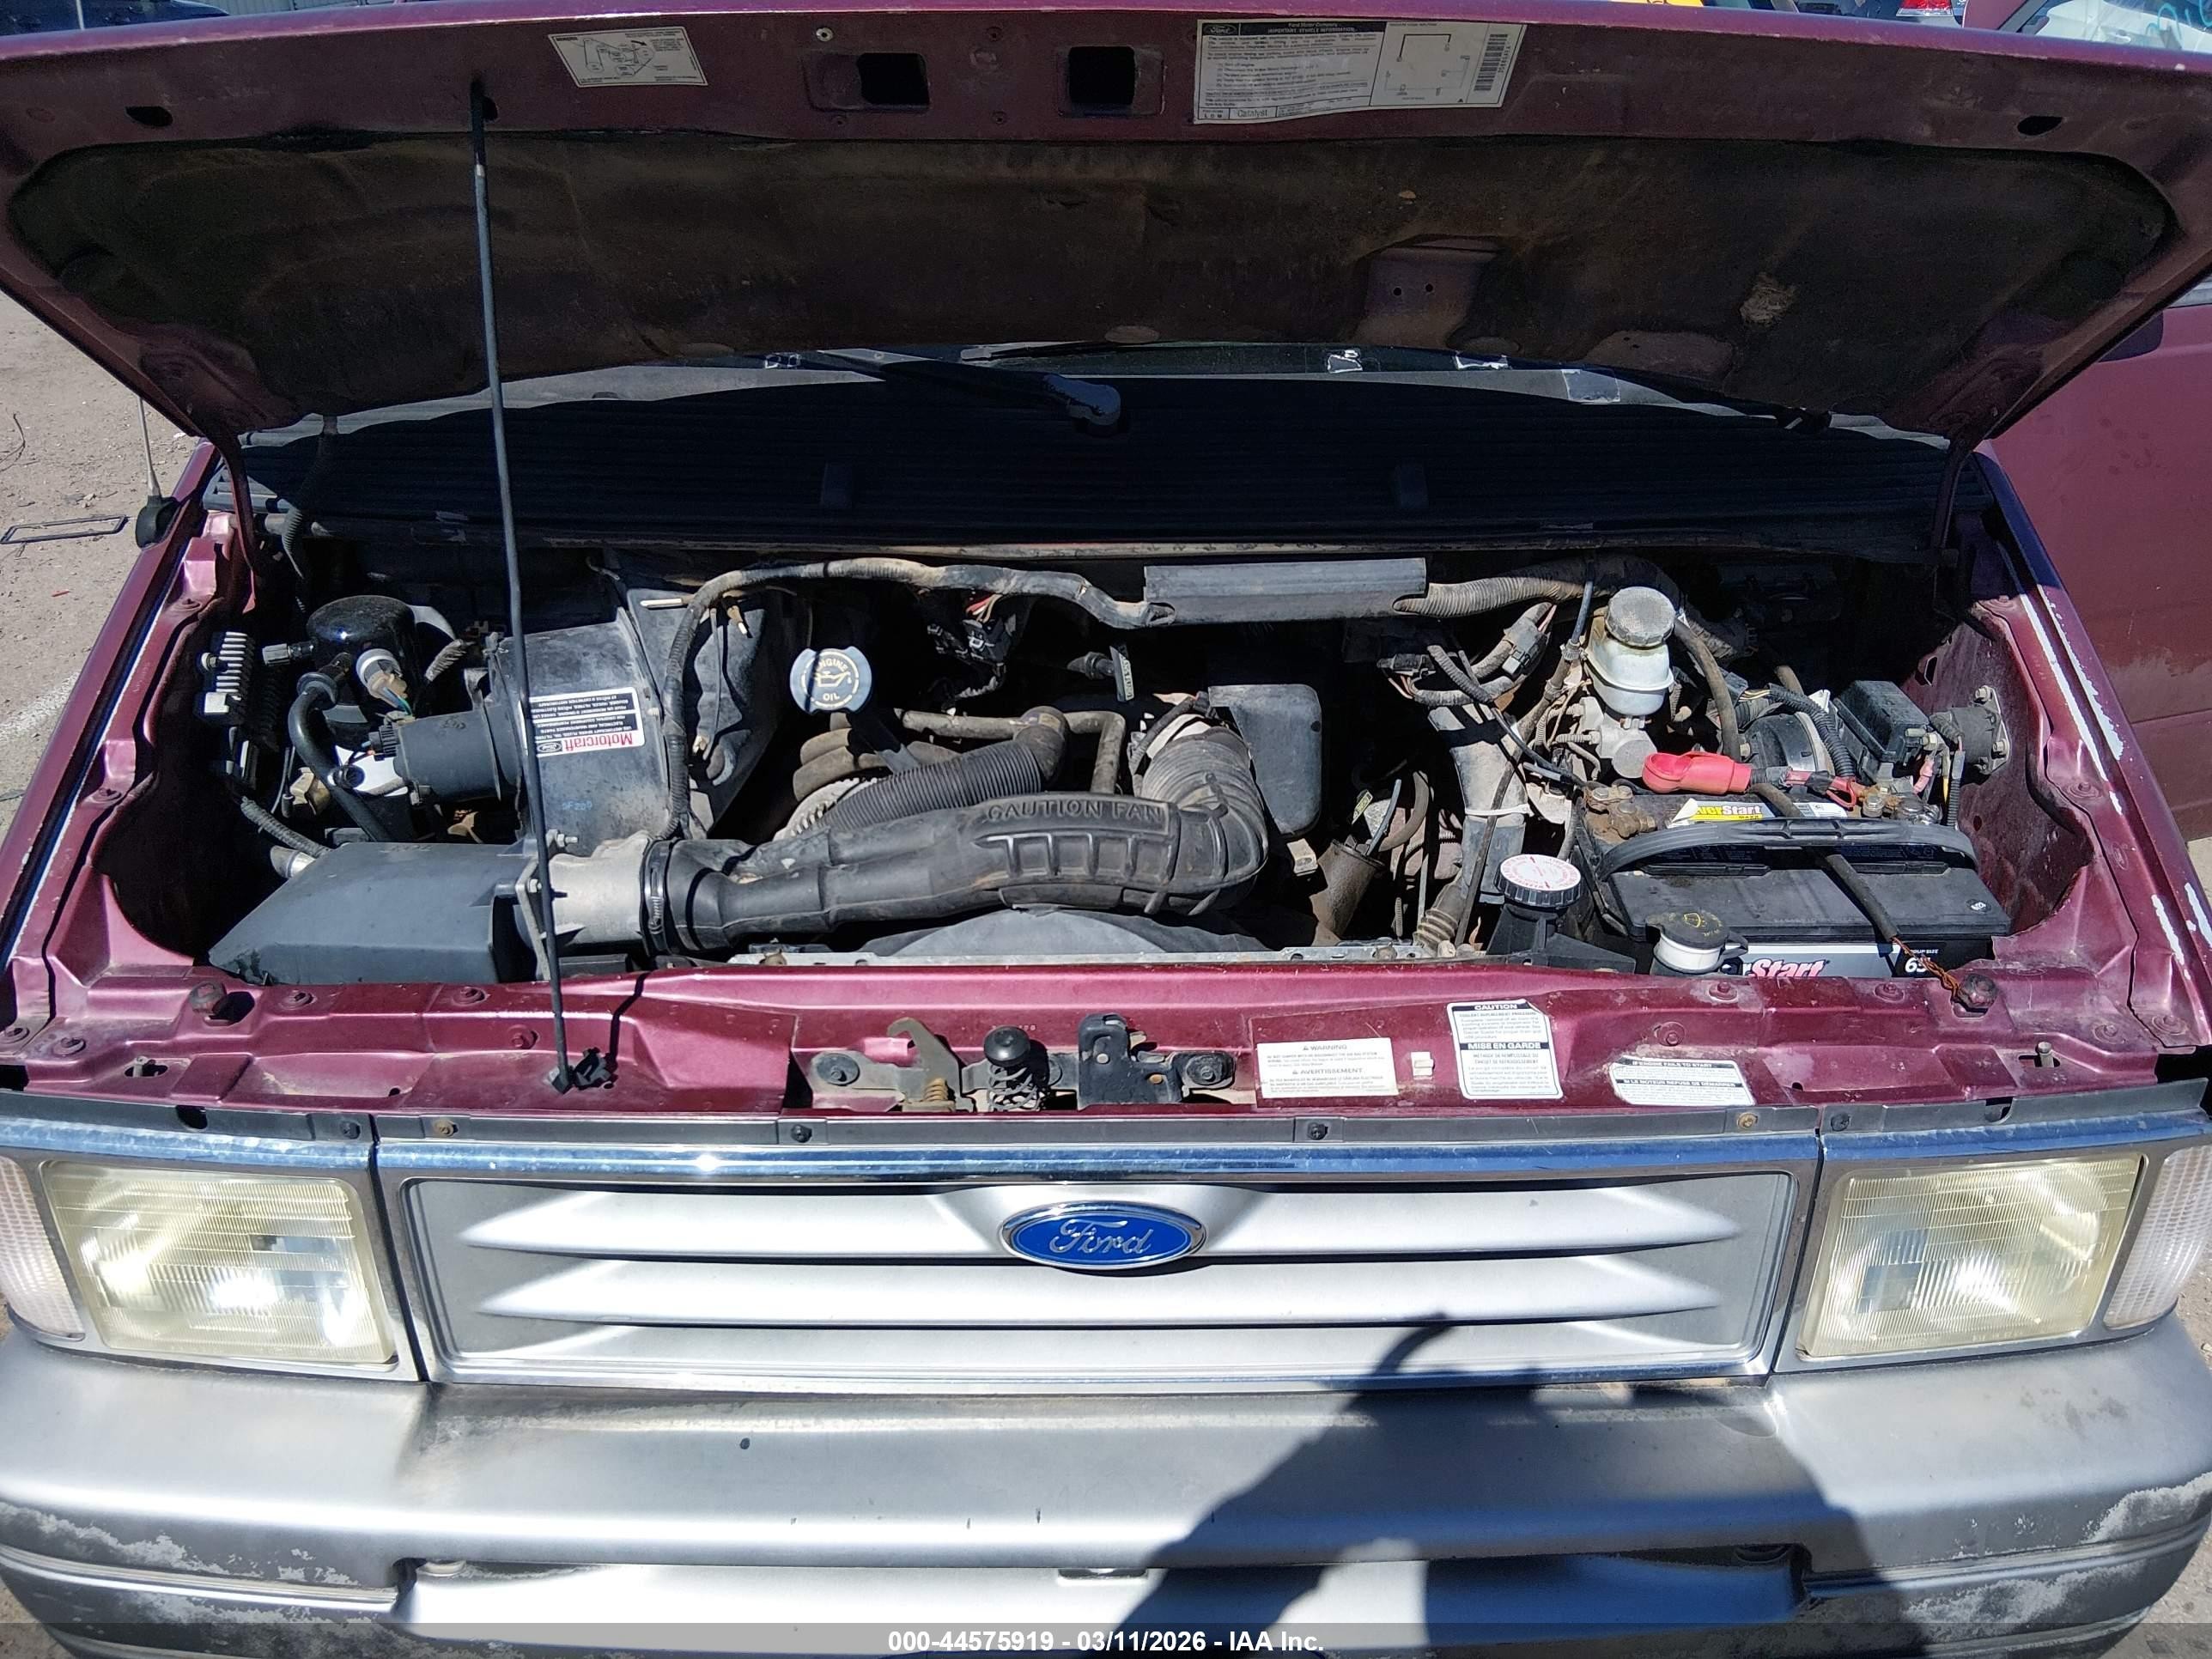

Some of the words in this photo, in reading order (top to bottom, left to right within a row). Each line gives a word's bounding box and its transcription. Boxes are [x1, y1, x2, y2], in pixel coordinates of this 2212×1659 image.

[1237, 108, 1267, 118] Catalyst
[563, 732, 634, 751] Motorcraft
[987, 799, 1102, 821] CAUTION
[1111, 801, 1164, 822] FAN
[1049, 1218, 1155, 1254] Ford
